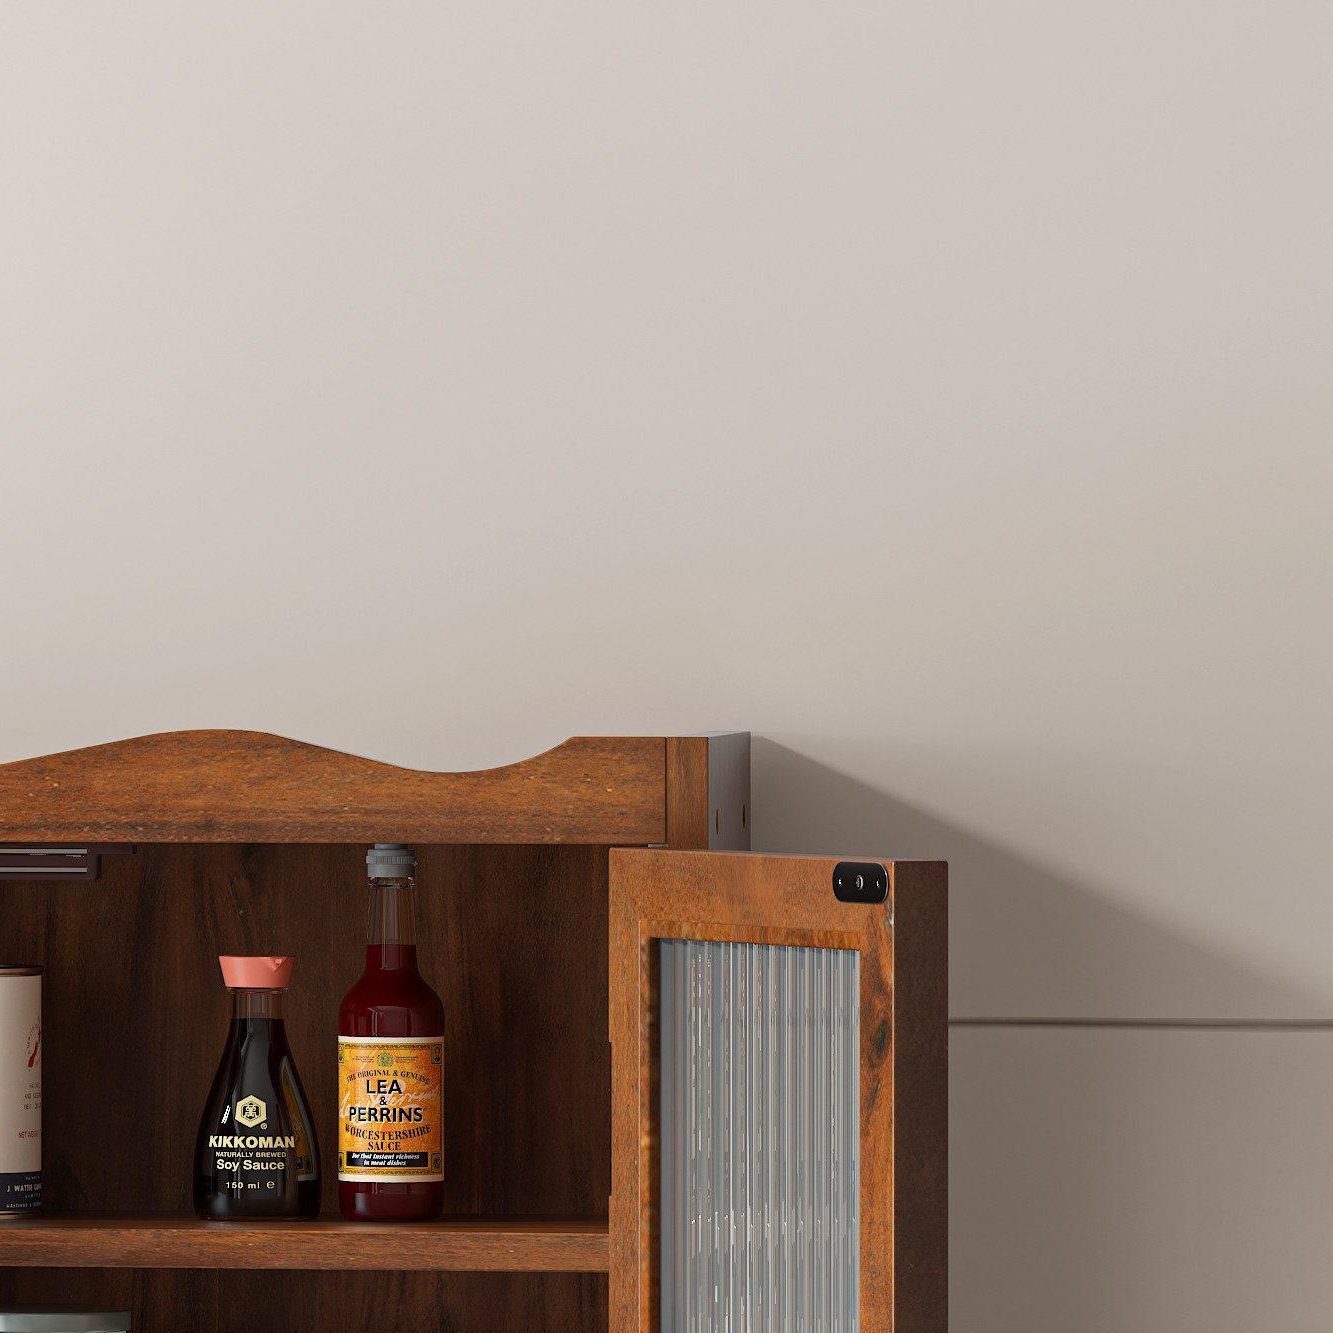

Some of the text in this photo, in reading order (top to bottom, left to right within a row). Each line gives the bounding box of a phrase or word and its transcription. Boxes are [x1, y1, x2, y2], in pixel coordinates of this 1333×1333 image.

[357, 1070, 391, 1079] ORIGINAL
[366, 1080, 402, 1094] LEA
[379, 1096, 388, 1106] &
[349, 1107, 423, 1122] PERRINS
[345, 1124, 432, 1141] WORCESTERSHIRE
[208, 1135, 295, 1149] KIKKOMAN
[368, 1141, 402, 1151] SAUCE
[216, 1159, 285, 1172] Soy Sauce
[225, 1181, 243, 1189] 150
[247, 1181, 260, 1189] ml
